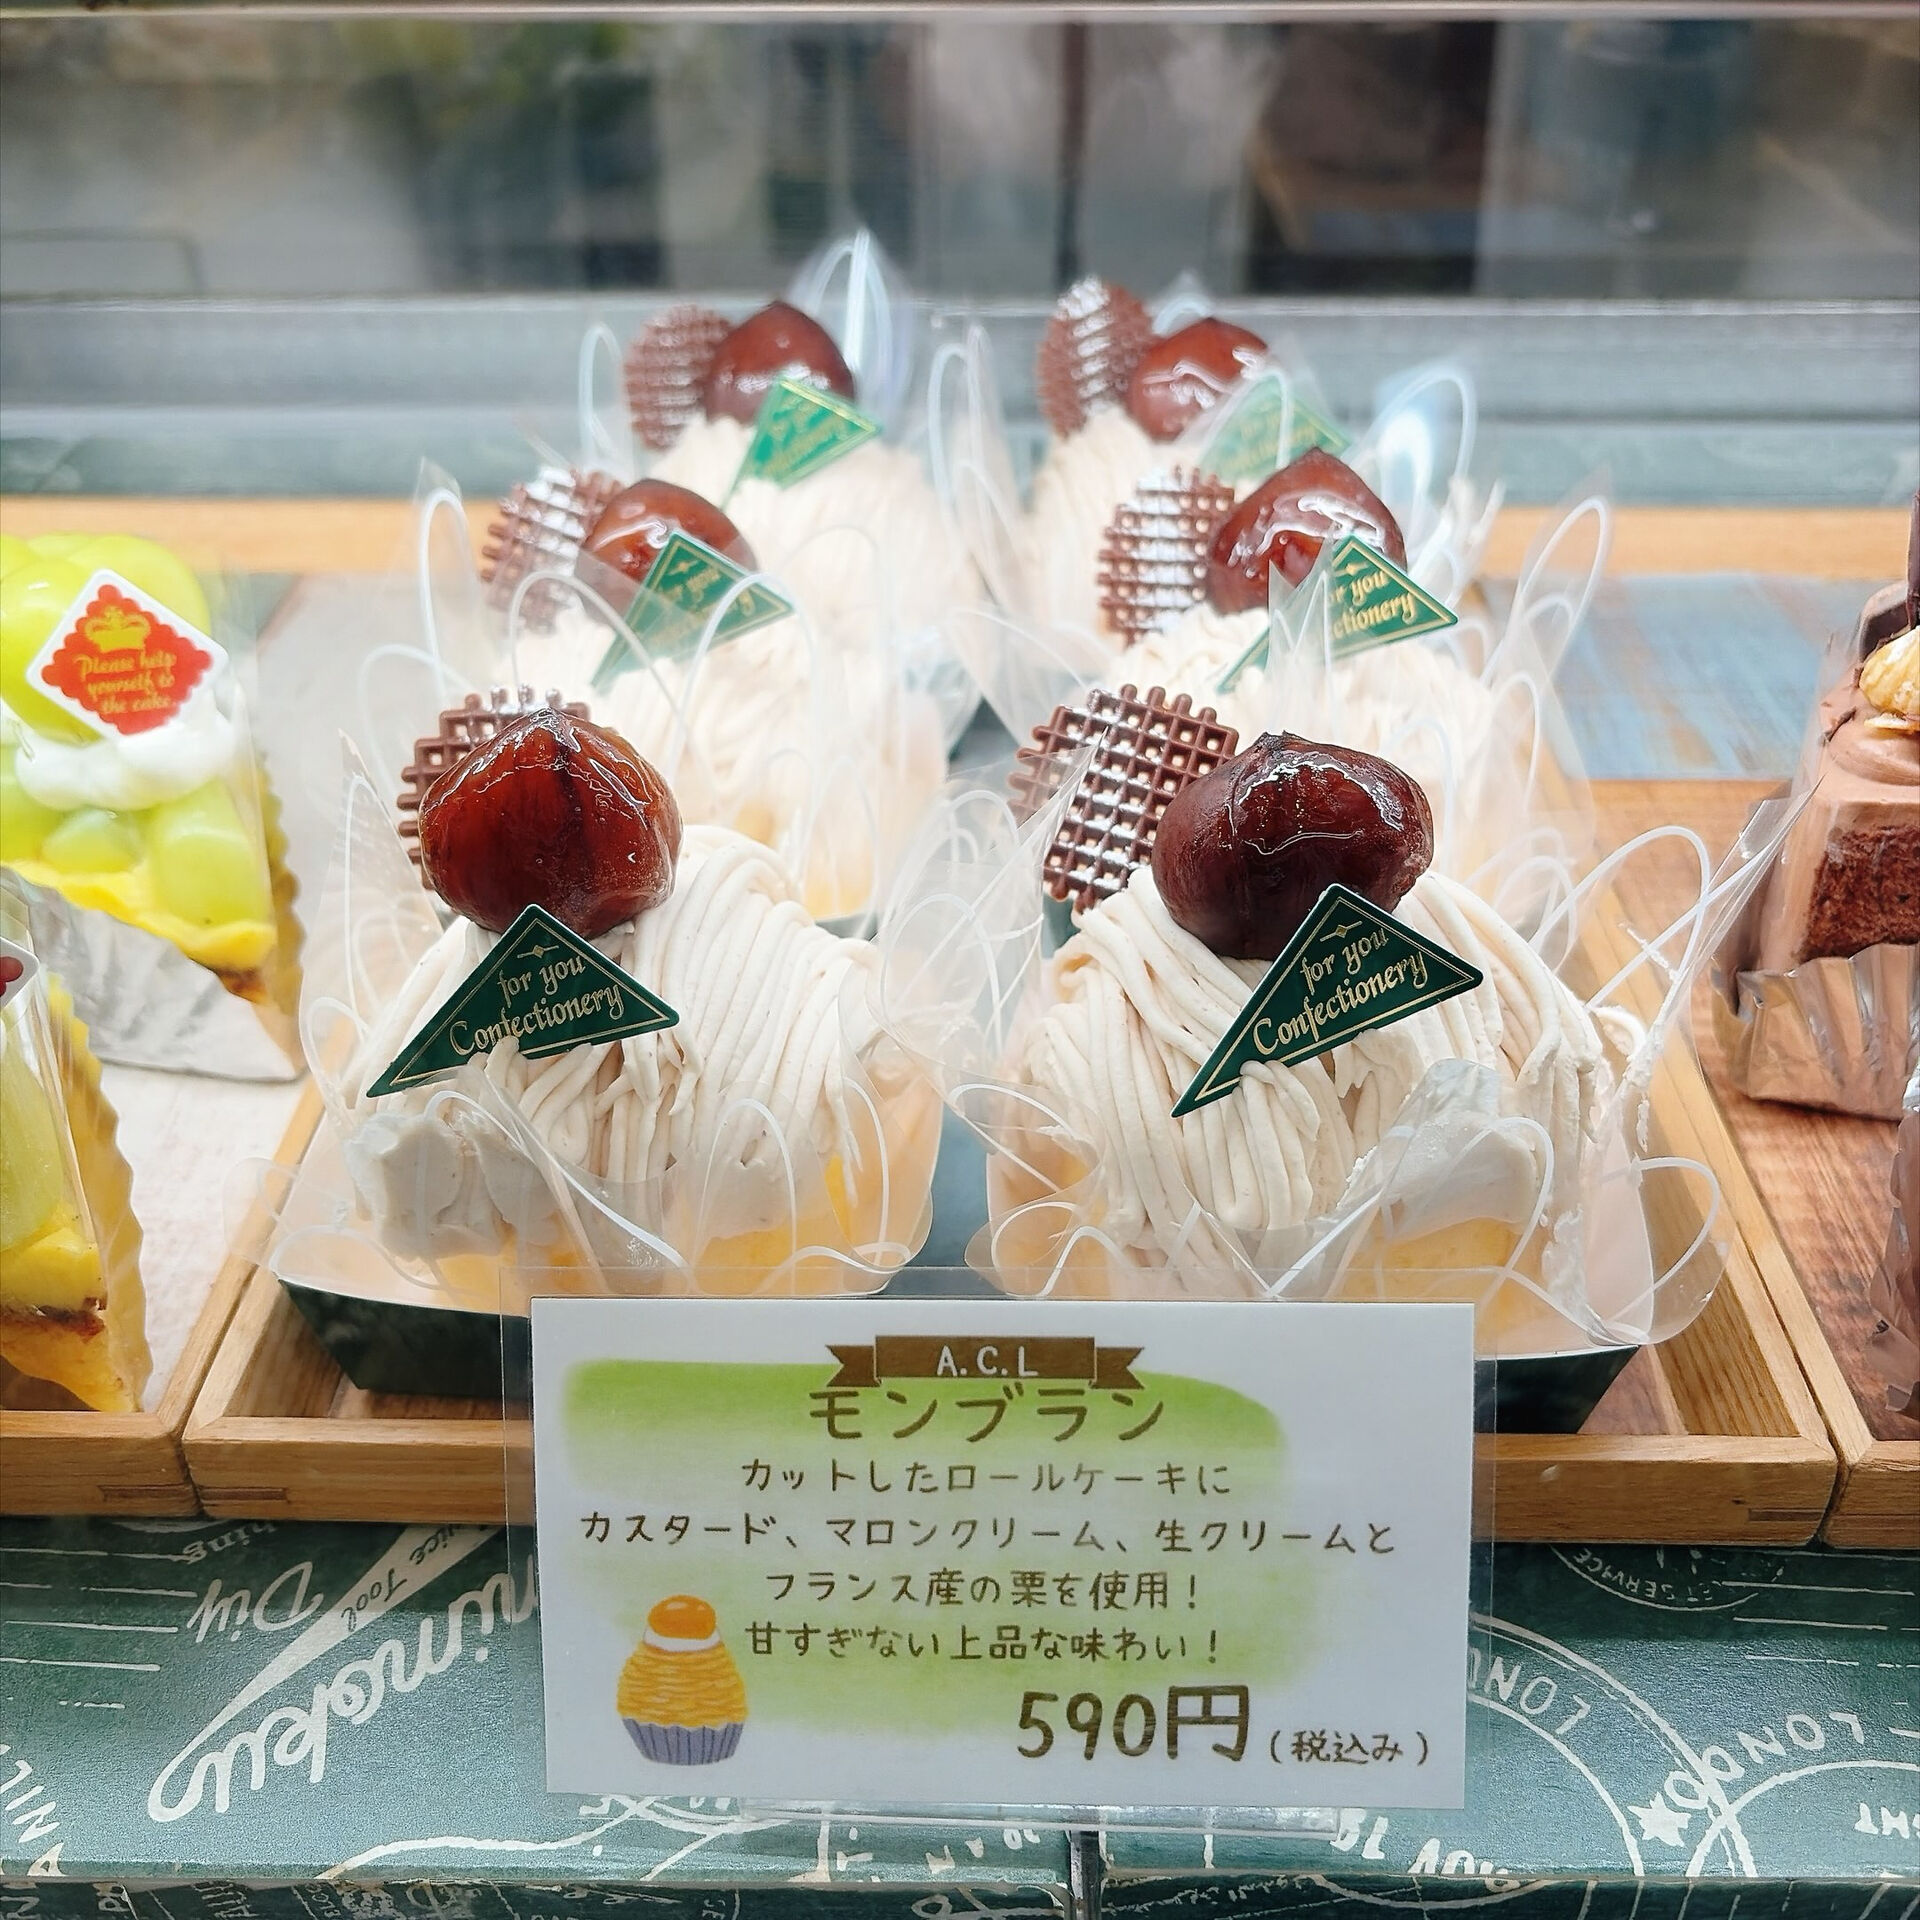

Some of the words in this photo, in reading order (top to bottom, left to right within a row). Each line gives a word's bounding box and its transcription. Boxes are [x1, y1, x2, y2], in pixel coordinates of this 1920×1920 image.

[1349, 570, 1389, 606] you
[1333, 592, 1416, 639] ctionery
[498, 970, 532, 1008] for
[539, 955, 585, 995] you
[1300, 953, 1336, 996] for
[1342, 927, 1389, 975] you
[449, 984, 625, 1056] Confectionery
[1253, 951, 1429, 1055] Confectionery
[937, 1346, 1040, 1377] A.C.L
[809, 1382, 1165, 1445] モンブラン
[742, 1459, 1231, 1497] カットしたロールケーキに
[581, 1512, 1395, 1556] カスタード、マロンクリーム、生クリームと
[187, 1560, 326, 1643] Diy
[766, 1568, 1198, 1609] フランス産の栗を使用！
[744, 1622, 1219, 1664] 甘すぎない上品な味わい！
[1017, 1684, 1252, 1764] 590円
